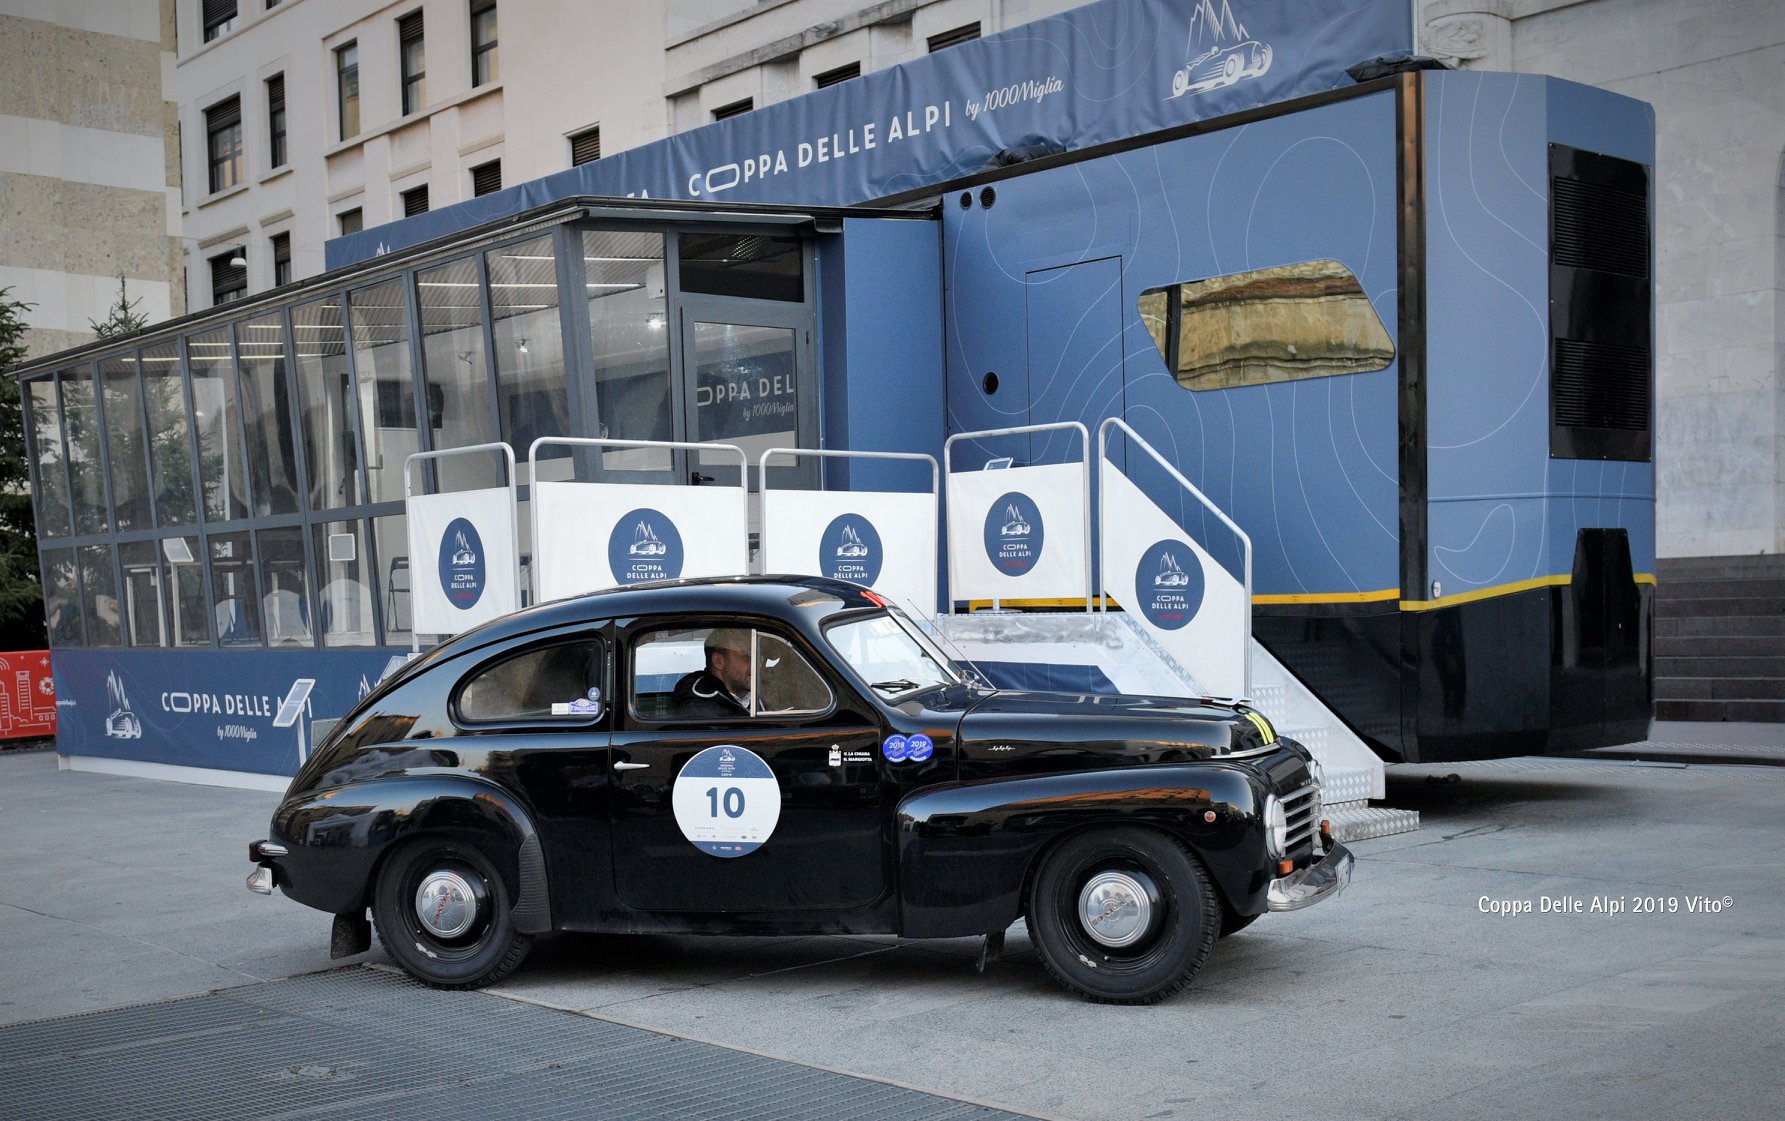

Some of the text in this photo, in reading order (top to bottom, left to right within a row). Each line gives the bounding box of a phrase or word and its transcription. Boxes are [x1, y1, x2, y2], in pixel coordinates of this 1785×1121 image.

[688, 150, 788, 197] COPPA
[798, 123, 876, 168] DELLE
[888, 100, 950, 143] ALPI
[965, 99, 980, 121] by
[161, 692, 222, 714] COPPA
[224, 694, 272, 717] DELLE
[706, 787, 745, 818] 10
